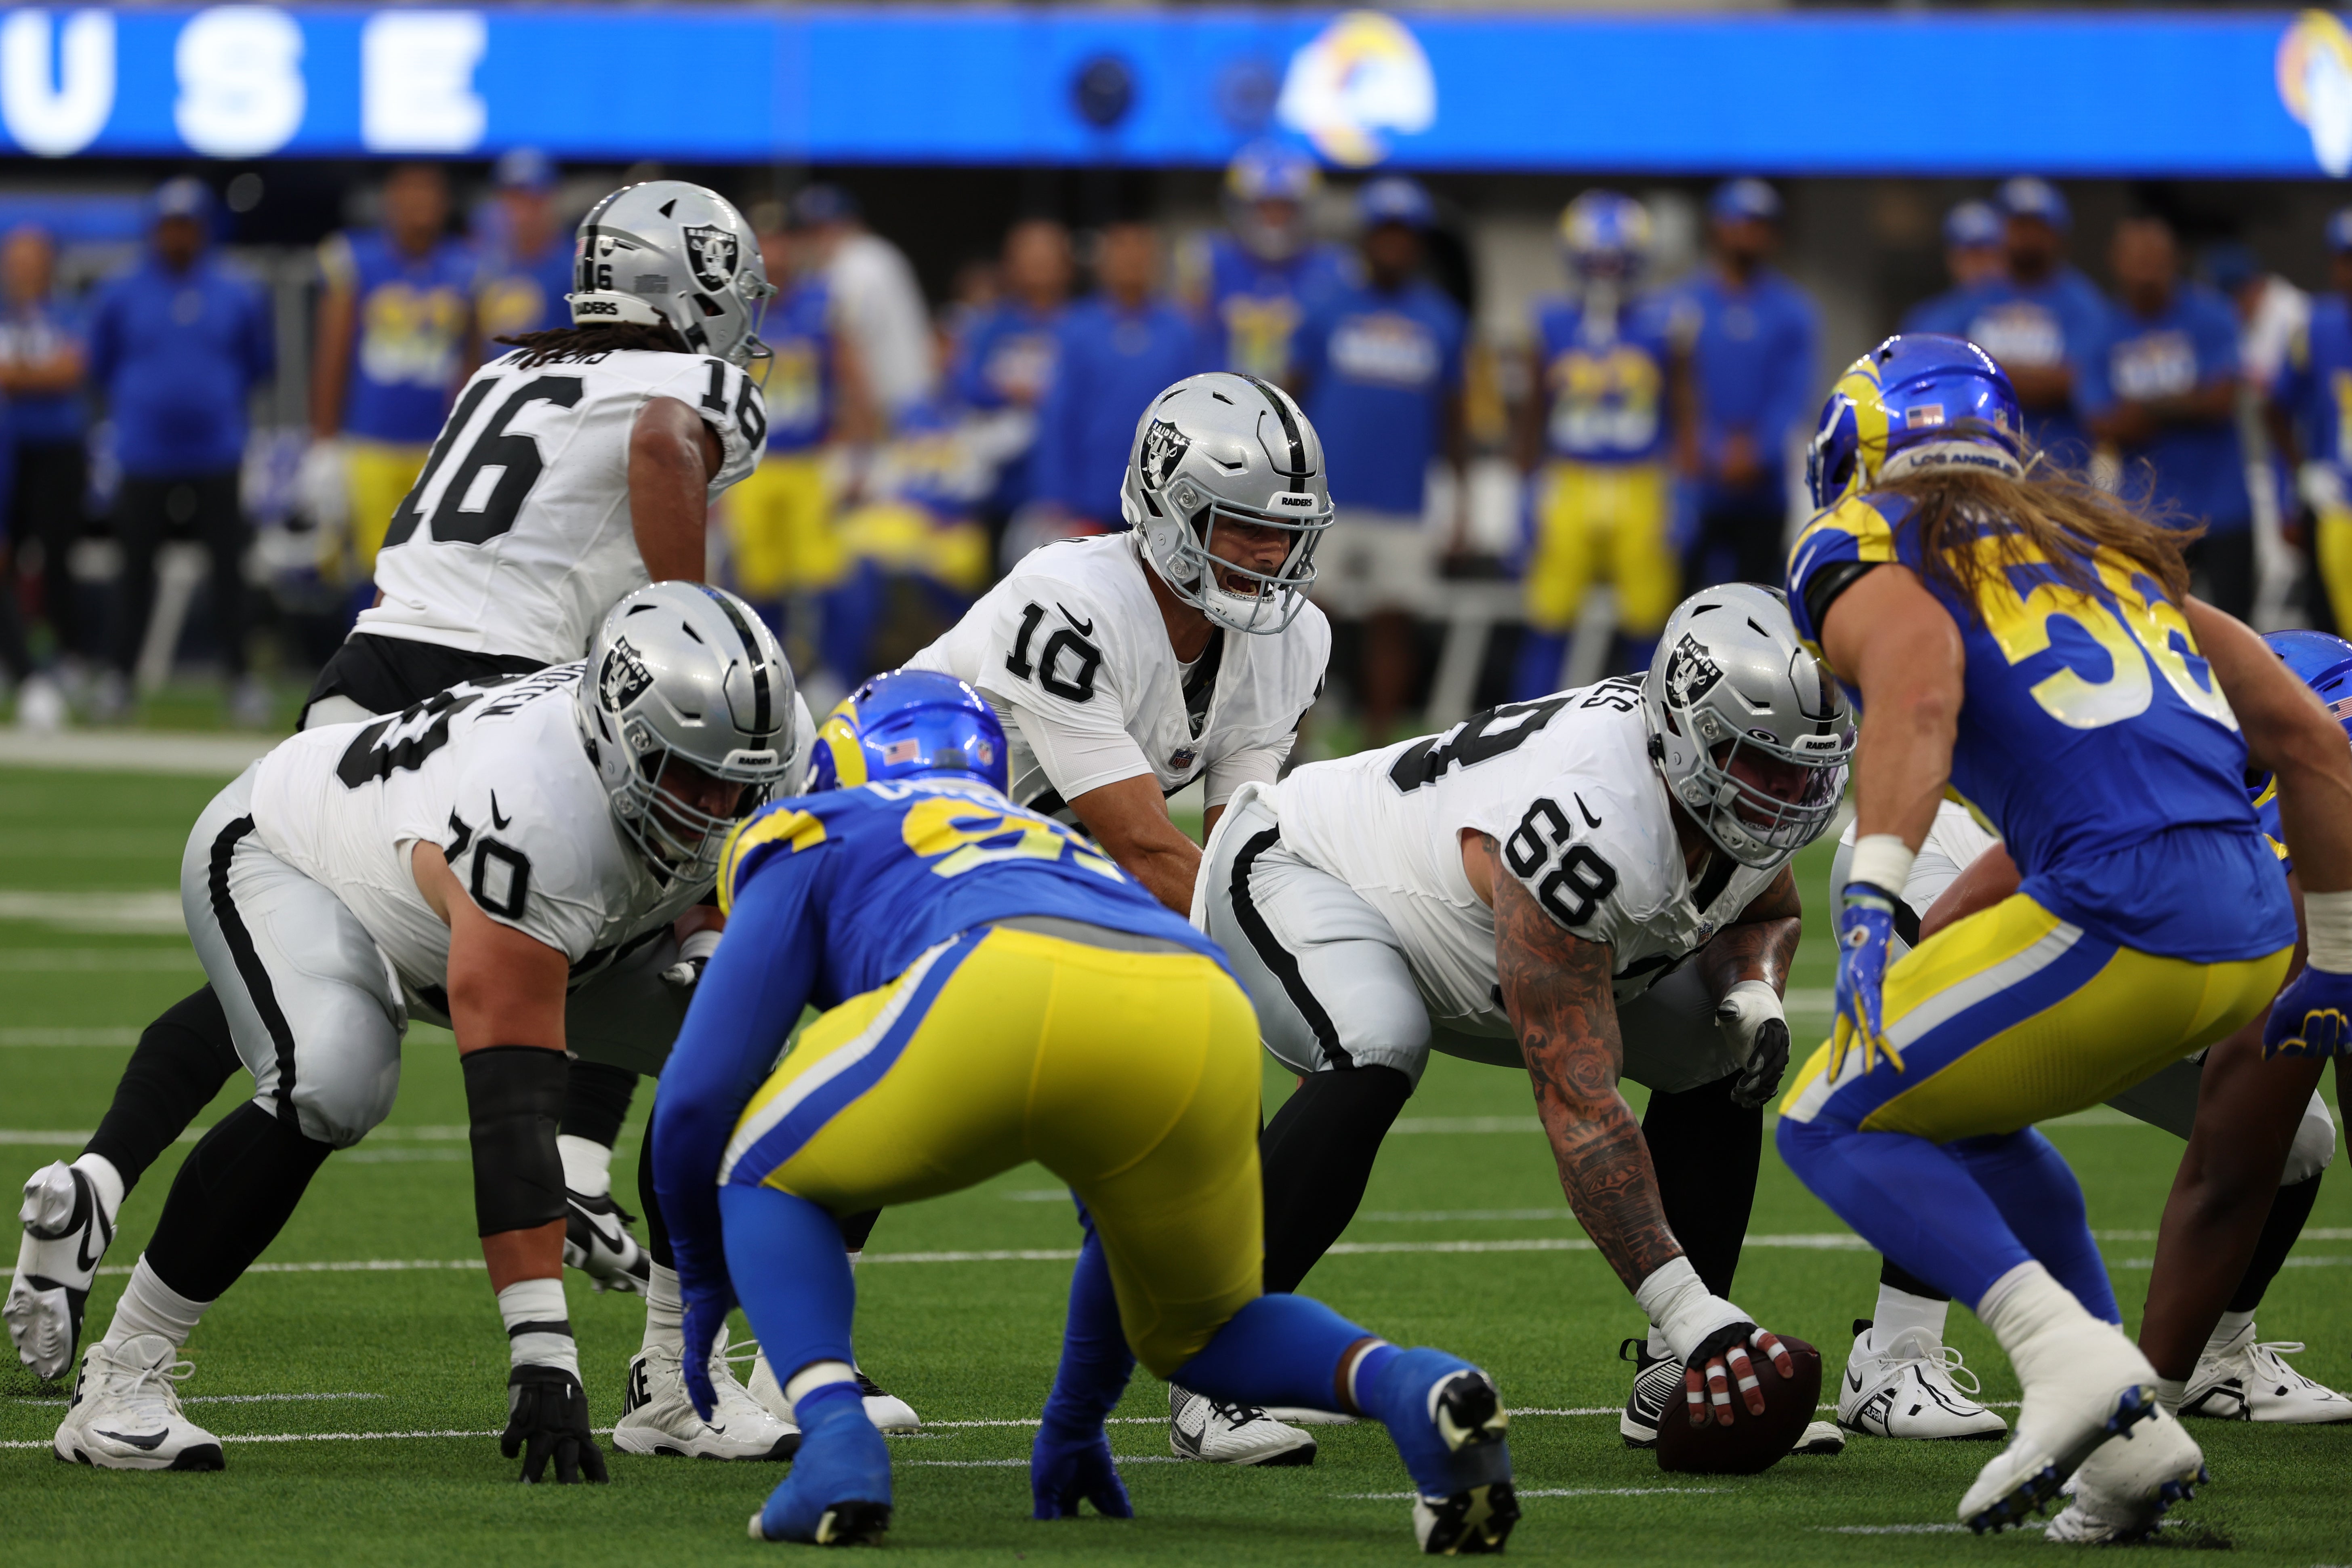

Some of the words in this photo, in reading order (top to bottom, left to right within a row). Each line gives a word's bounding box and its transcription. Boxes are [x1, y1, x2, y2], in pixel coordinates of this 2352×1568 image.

[702, 359, 766, 450] 16
[381, 376, 584, 546] 16
[1282, 497, 1312, 507] RAIDERS
[618, 640, 649, 682] RAIDERS
[1005, 599, 1104, 704] 10
[1684, 637, 1718, 677] RAIDERS
[1173, 757, 1189, 767] NFL
[1806, 741, 1837, 750] RAIDERS
[1504, 797, 1617, 927] 68
[1863, 1405, 1882, 1423] ALPHA
